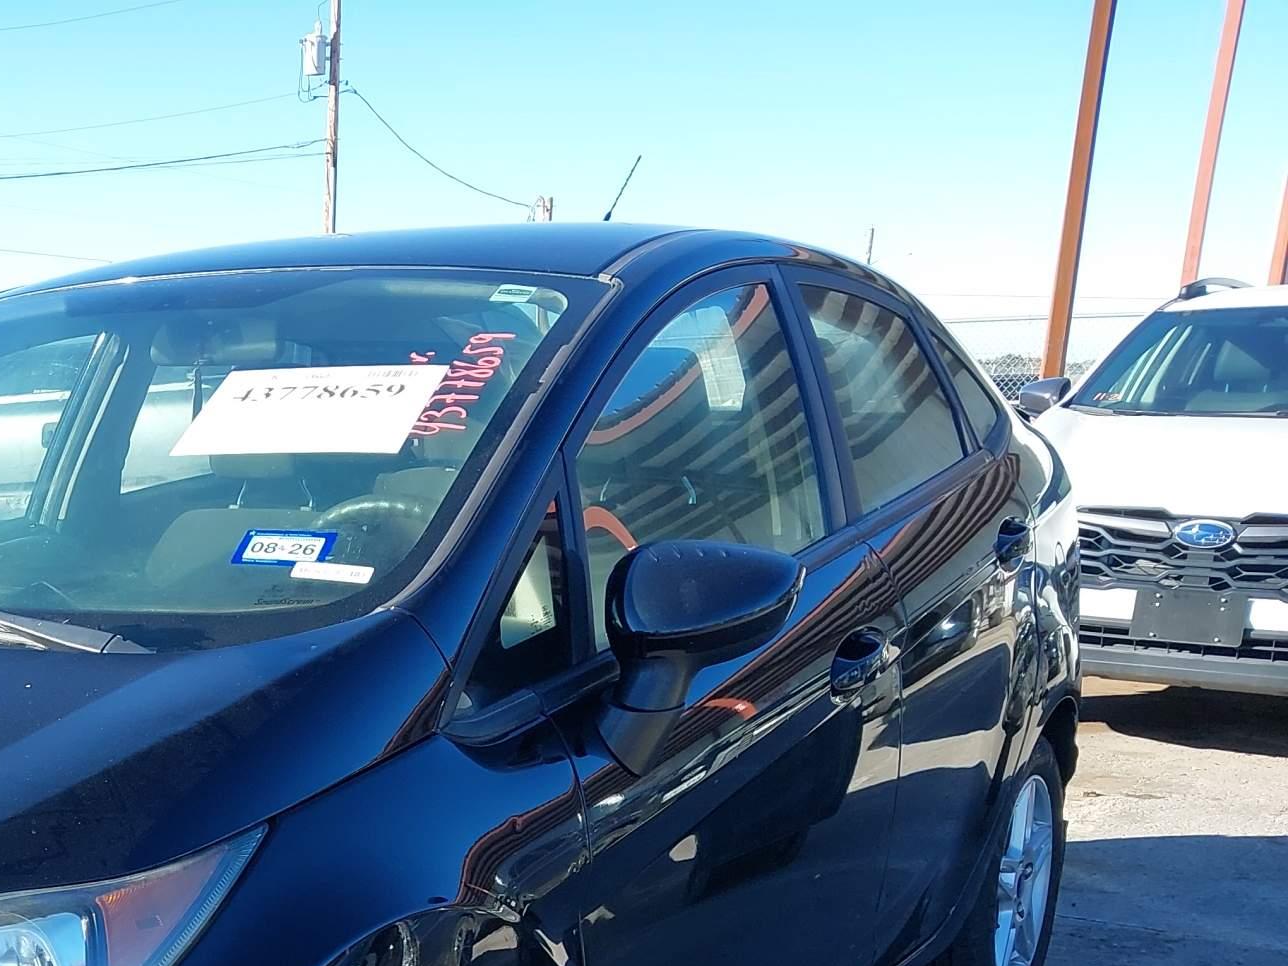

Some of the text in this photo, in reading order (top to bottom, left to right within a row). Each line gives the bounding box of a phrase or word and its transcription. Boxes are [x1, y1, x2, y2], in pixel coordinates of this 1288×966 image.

[410, 332, 517, 436] 43778659
[232, 385, 406, 402] 43778659
[249, 541, 318, 556] 08 26
